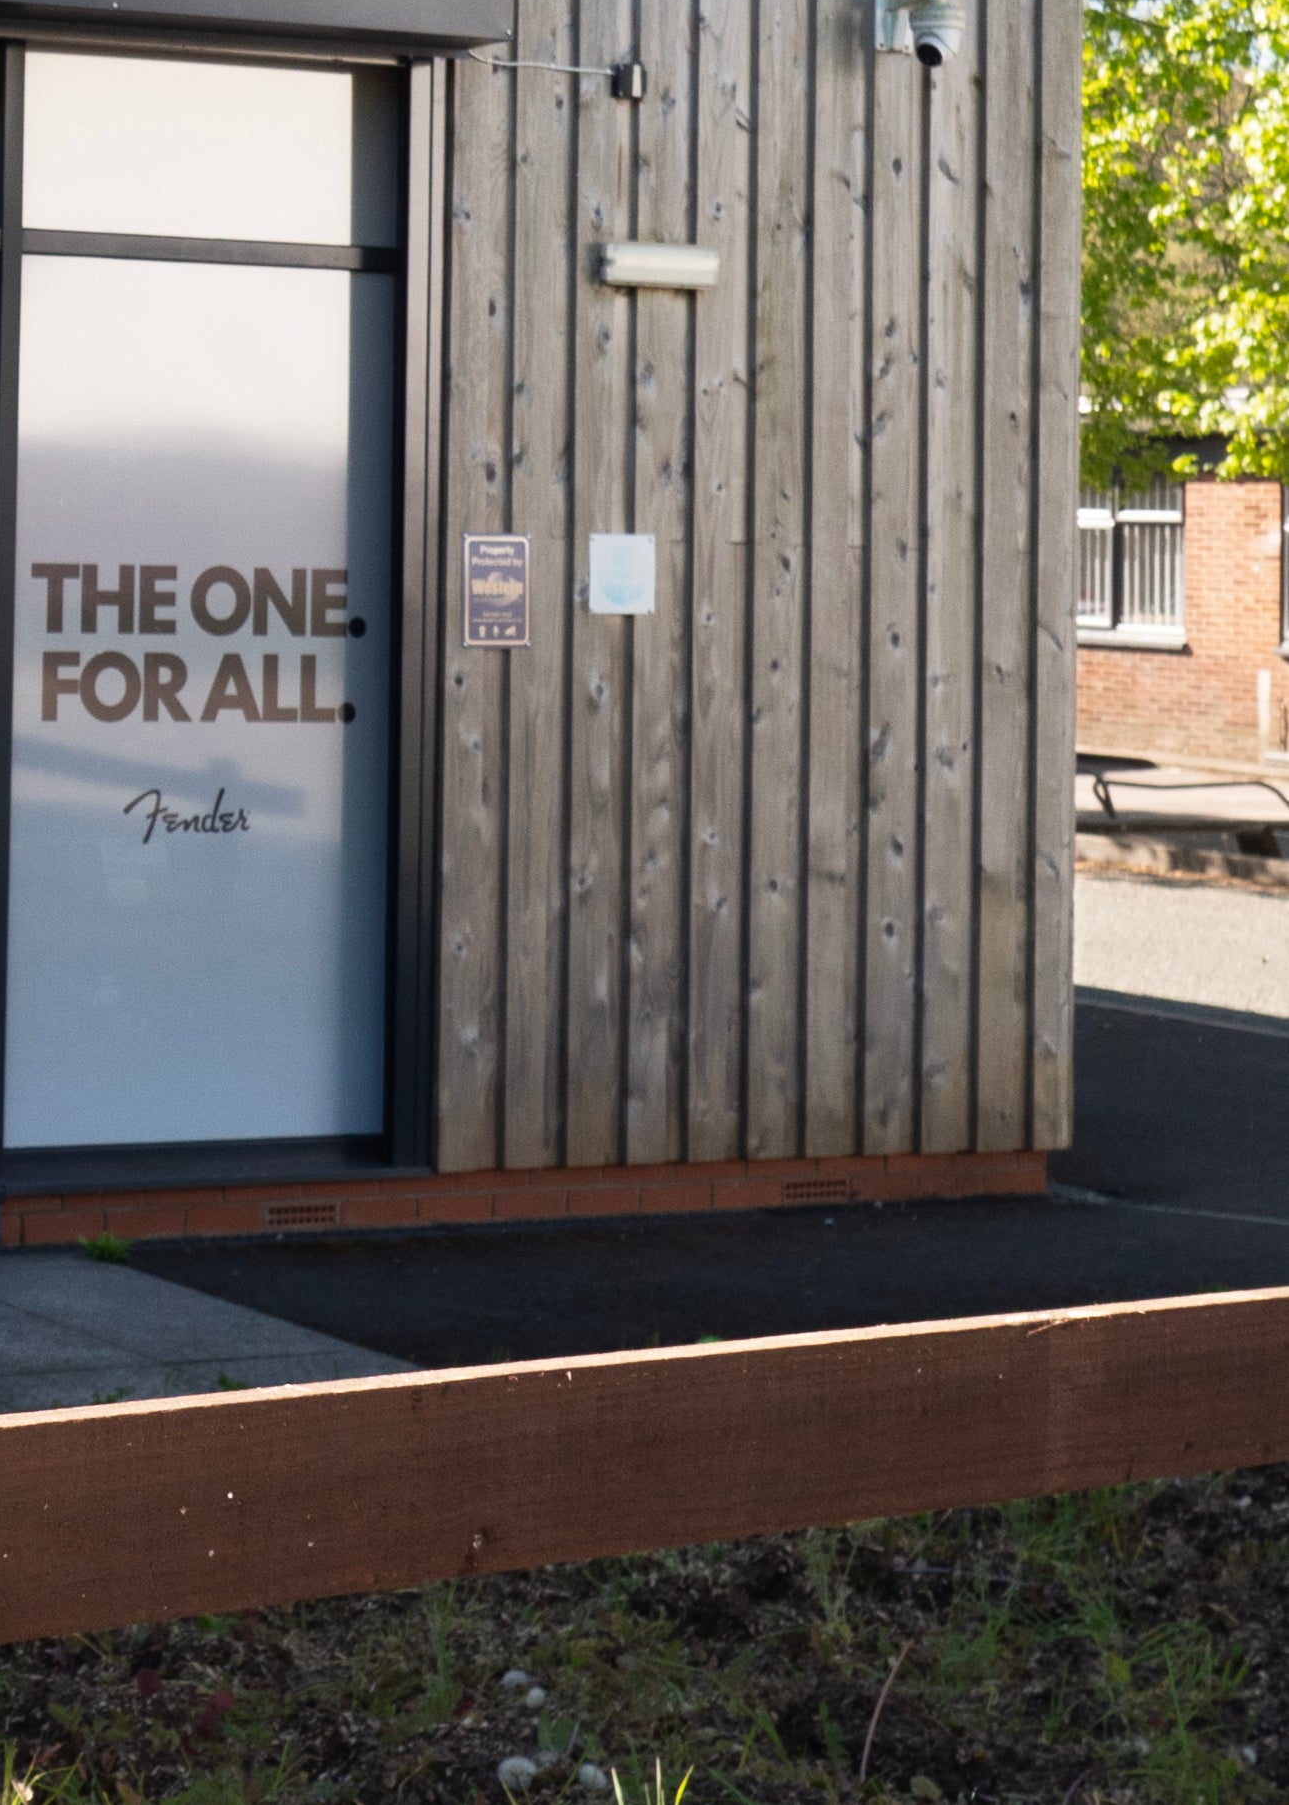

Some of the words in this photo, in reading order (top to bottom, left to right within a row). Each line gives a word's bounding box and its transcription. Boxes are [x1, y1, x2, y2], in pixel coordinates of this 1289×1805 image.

[31, 562, 178, 635] THE
[190, 565, 367, 639] ONE.
[41, 650, 192, 723] FOR
[200, 652, 357, 725] ALL.
[123, 787, 251, 845] Fender
